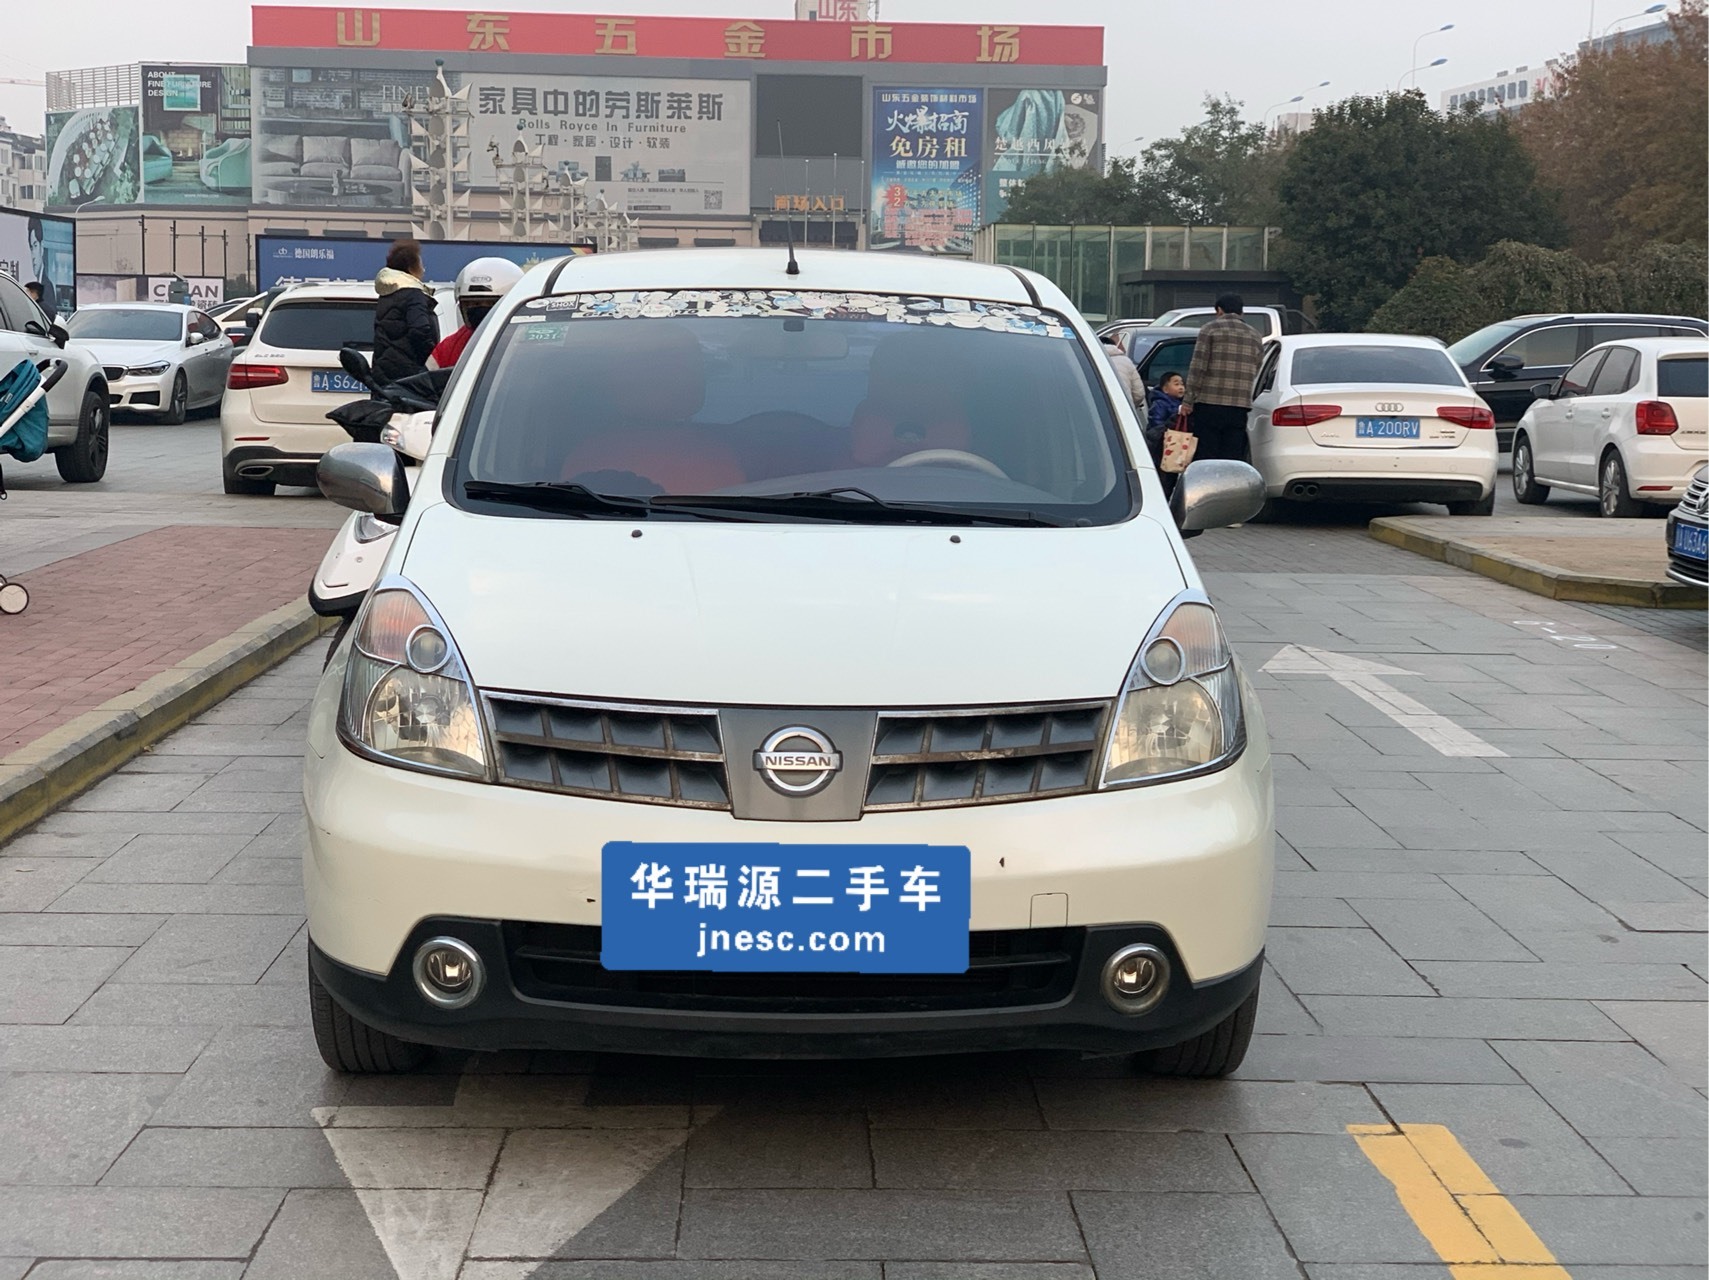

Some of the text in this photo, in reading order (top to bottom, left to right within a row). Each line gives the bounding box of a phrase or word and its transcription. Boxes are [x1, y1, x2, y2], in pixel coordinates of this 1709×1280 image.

[336, 9, 1020, 63] 山东五金市场
[147, 71, 176, 79] ABOUT
[478, 85, 724, 121] 家具中的劳斯莱斯
[881, 93, 977, 104] 山东五金装饰材料市场
[518, 117, 687, 133] Rolls Royce In Furniture
[885, 105, 970, 134] 火爆招商
[889, 135, 968, 158] 免房租
[775, 194, 844, 211] 商场入口
[294, 247, 335, 260] 德国朗乐福
[765, 754, 833, 768] NISSAN
